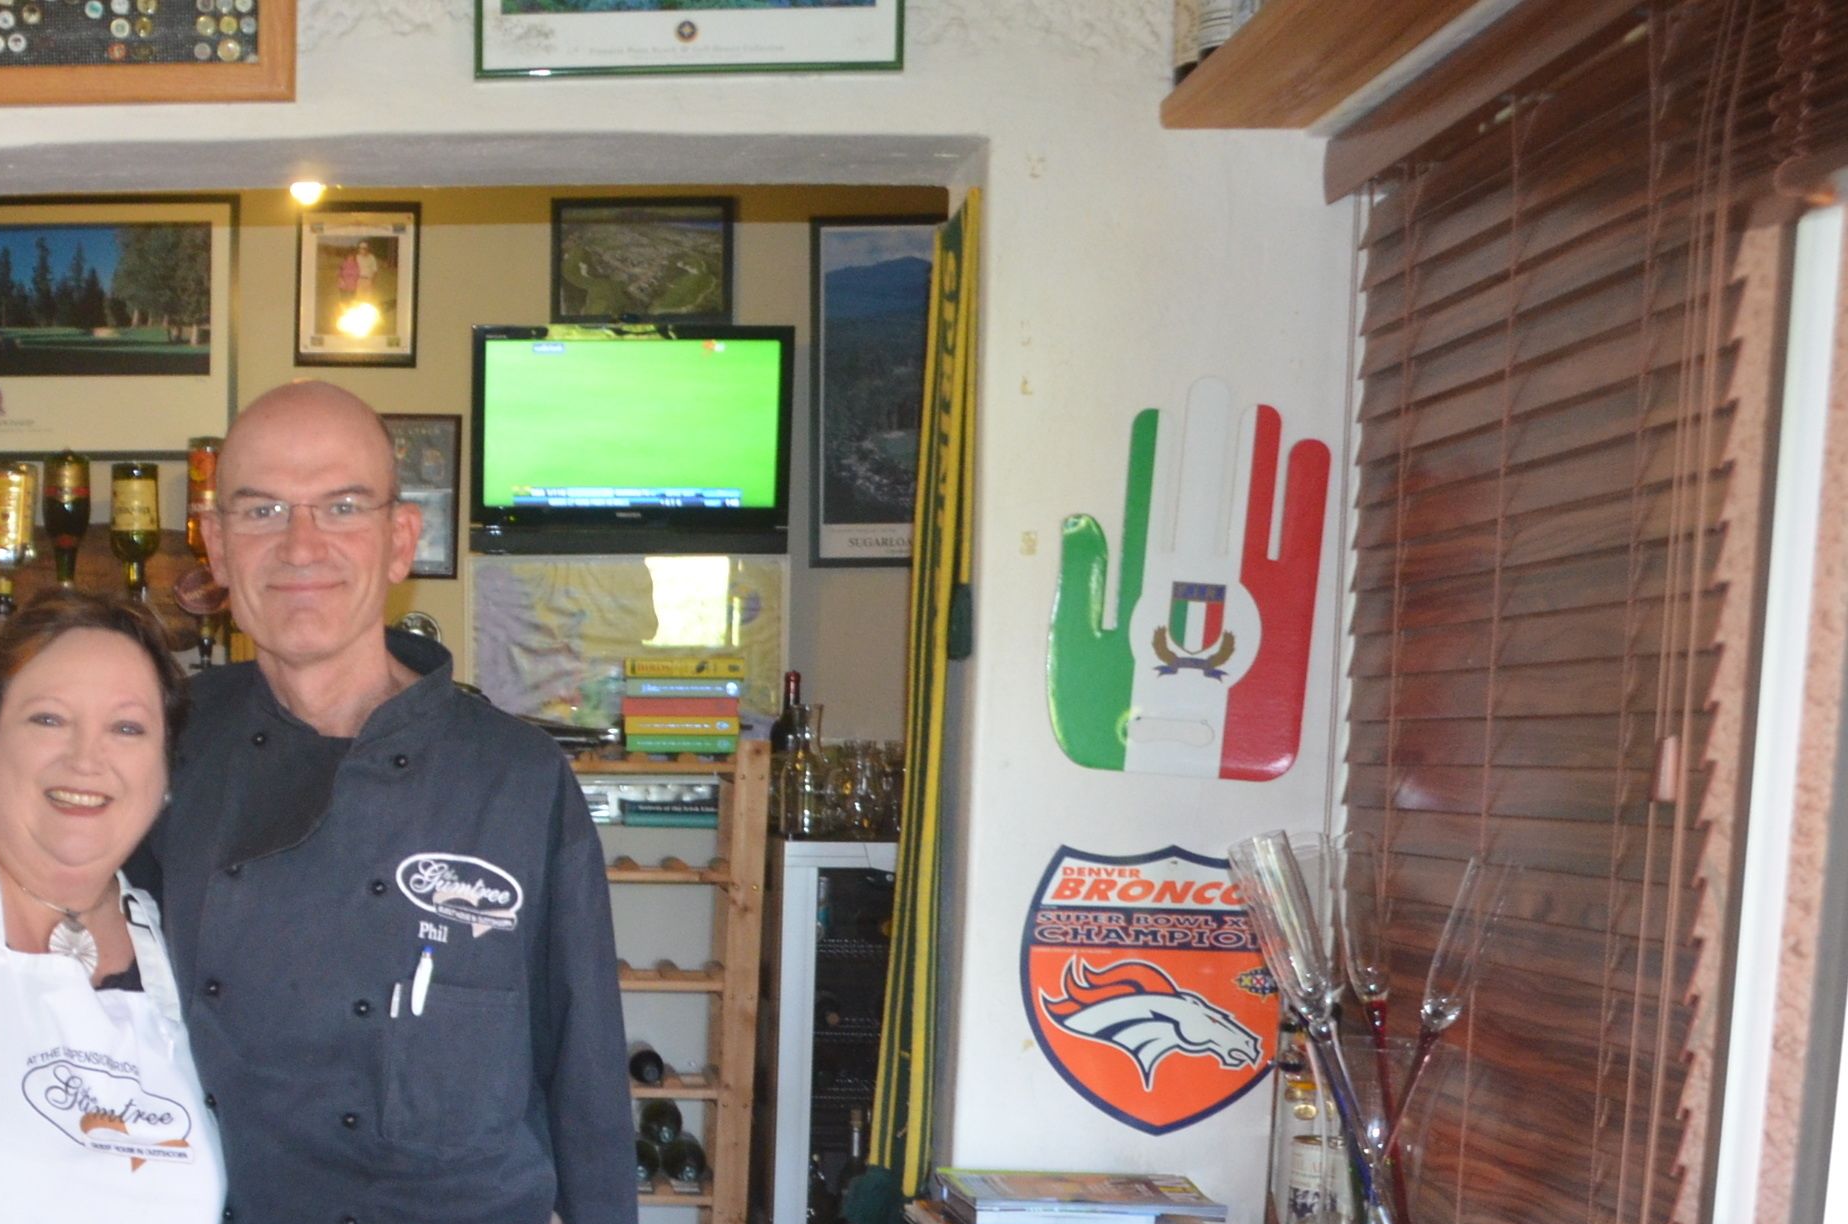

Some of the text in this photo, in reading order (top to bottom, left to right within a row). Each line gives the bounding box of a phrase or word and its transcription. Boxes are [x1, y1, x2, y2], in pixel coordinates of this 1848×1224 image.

[1062, 865, 1141, 879] DENVER
[1050, 877, 1248, 905] BRONCO
[1036, 911, 1125, 926] SUPER
[1132, 912, 1217, 929] BOWL
[417, 920, 449, 943] Phil
[26, 1054, 38, 1066] AT
[40, 1046, 61, 1063] THE
